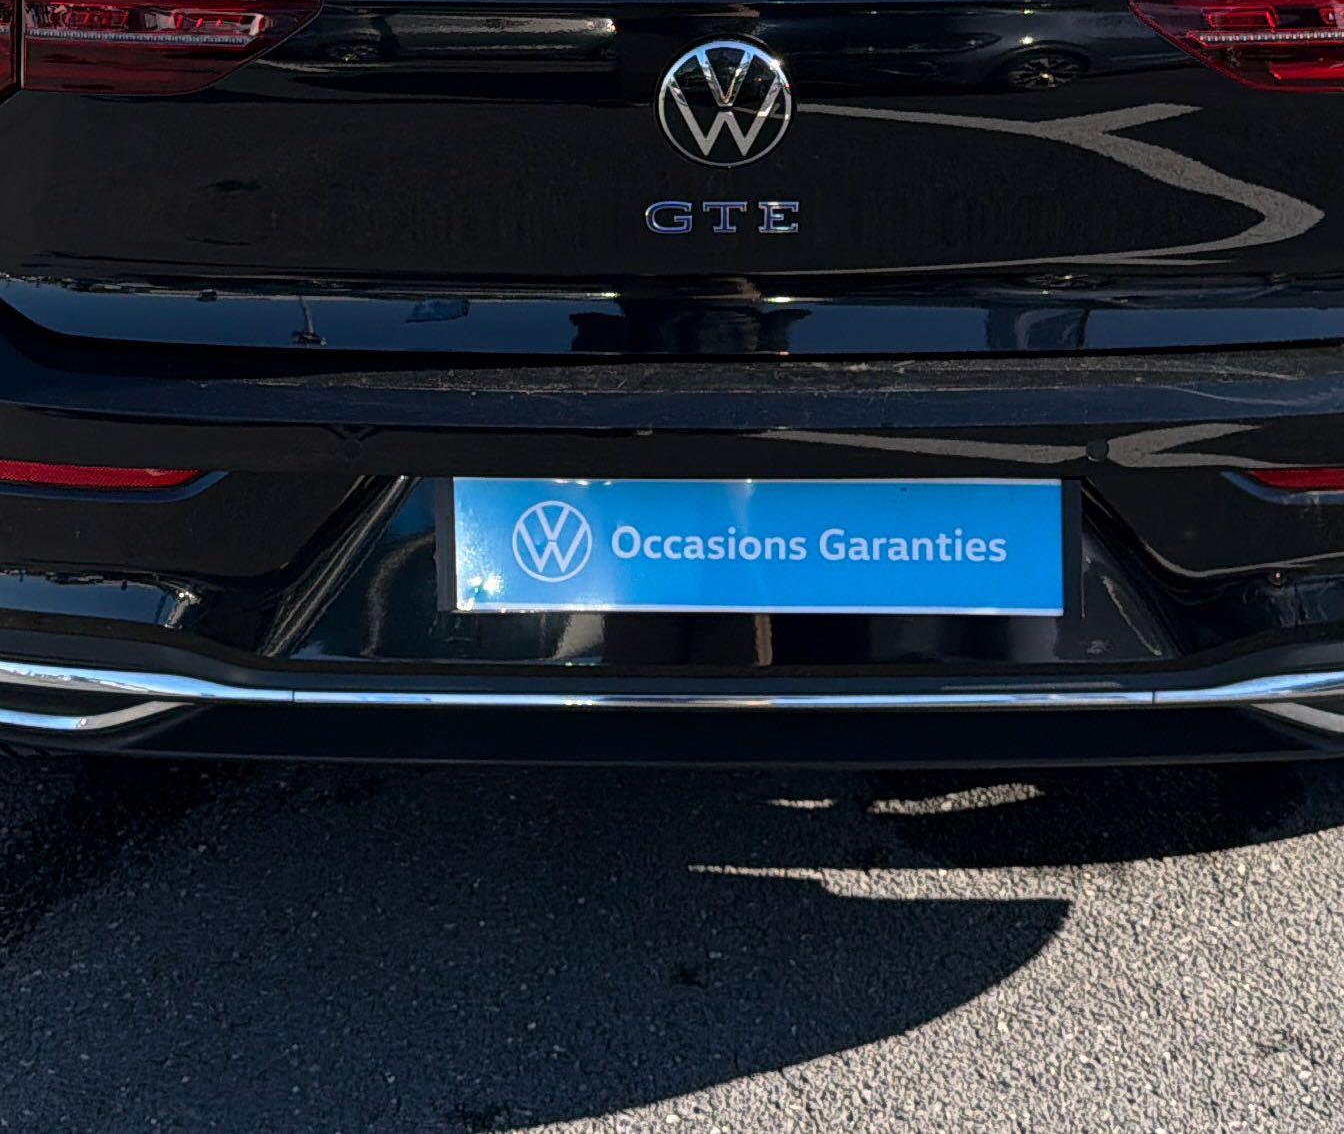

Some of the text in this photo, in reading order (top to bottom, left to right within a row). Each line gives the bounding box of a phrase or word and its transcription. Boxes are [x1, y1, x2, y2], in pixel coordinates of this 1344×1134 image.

[644, 201, 800, 234] GTE
[611, 526, 807, 561] Occasions
[819, 526, 1008, 564] Garanties
